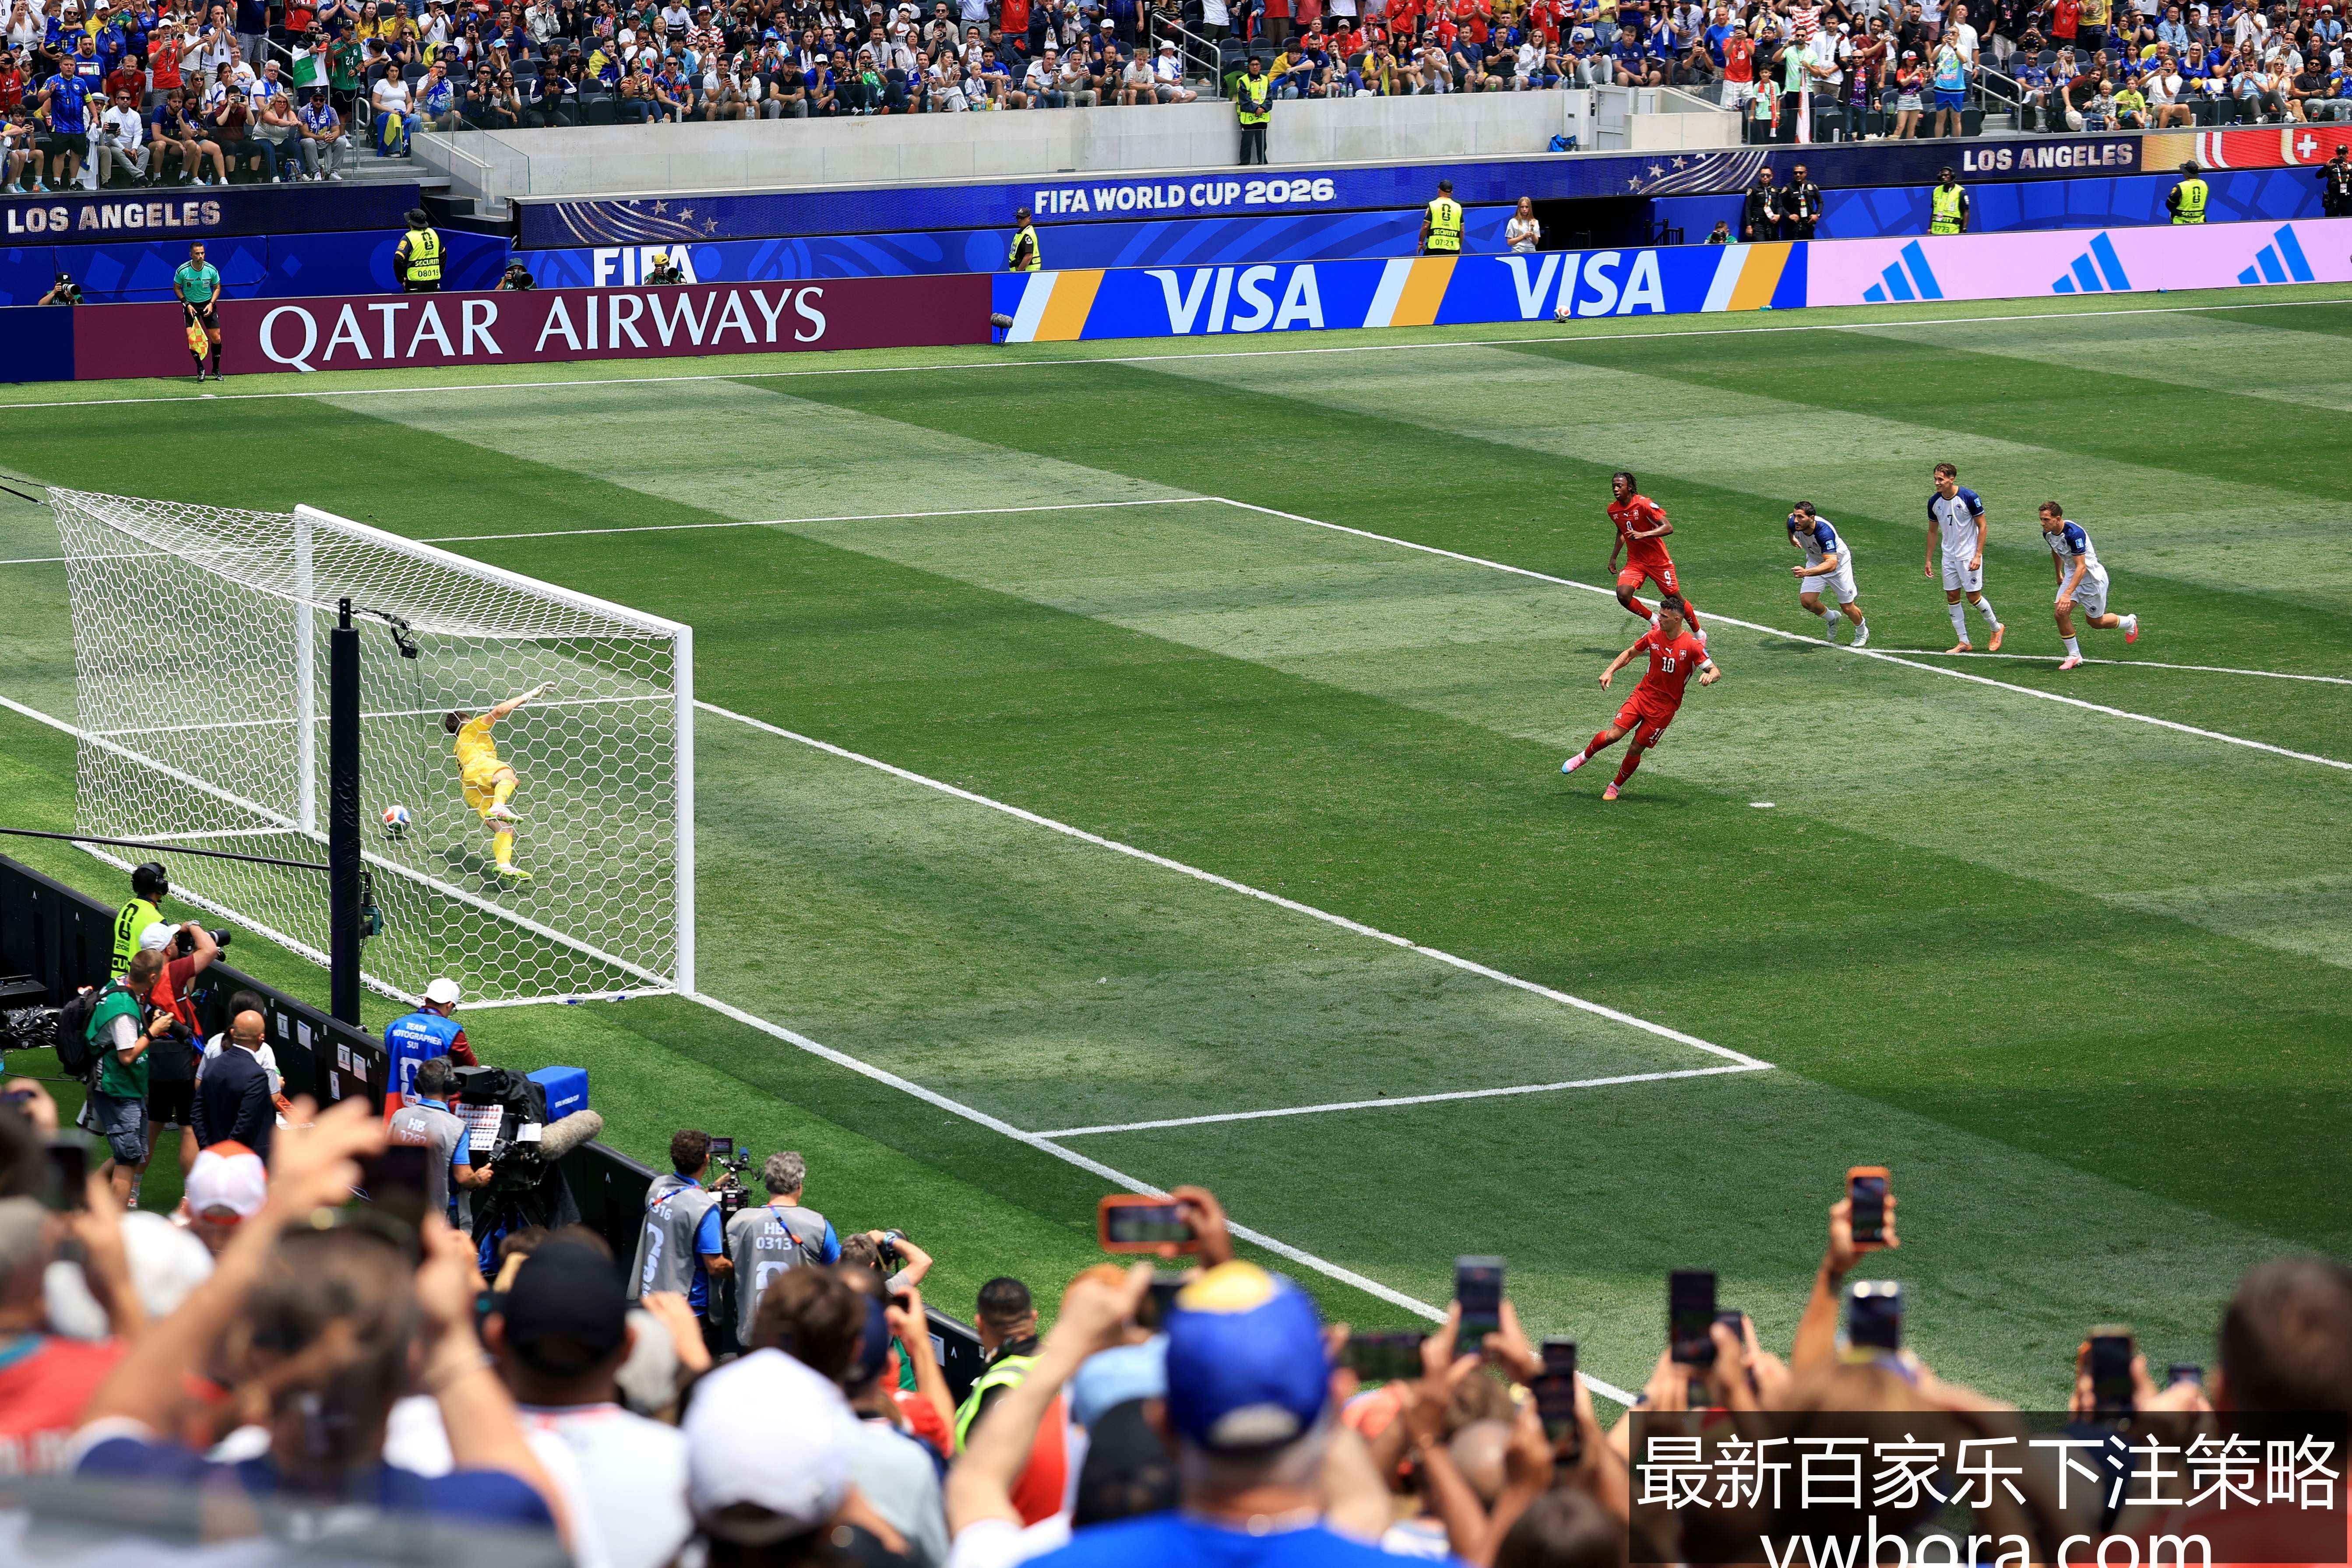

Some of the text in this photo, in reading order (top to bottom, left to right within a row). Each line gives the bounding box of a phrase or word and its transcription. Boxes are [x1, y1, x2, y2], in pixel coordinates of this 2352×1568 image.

[1963, 144, 2133, 171] LOS ANGELES
[1035, 178, 1335, 214] FIFA WORLD CUP 2026
[7, 201, 220, 233] LOS ANGELES
[593, 245, 697, 287] FIFA
[1495, 250, 1665, 319] VISA
[1144, 264, 1324, 334] VISA
[259, 286, 827, 372] QATAR AIRWAYS
[1947, 514, 1953, 526] 7
[1664, 570, 1672, 585] 9
[1662, 656, 1675, 673] 10
[1649, 728, 1665, 740] 10
[406, 1022, 427, 1032] TEAM
[392, 1029, 442, 1046] HOTOGRAPHER
[406, 1040, 419, 1050] SUI
[407, 1117, 426, 1132] HB
[764, 1222, 786, 1235] HB
[756, 1237, 793, 1251] 0313
